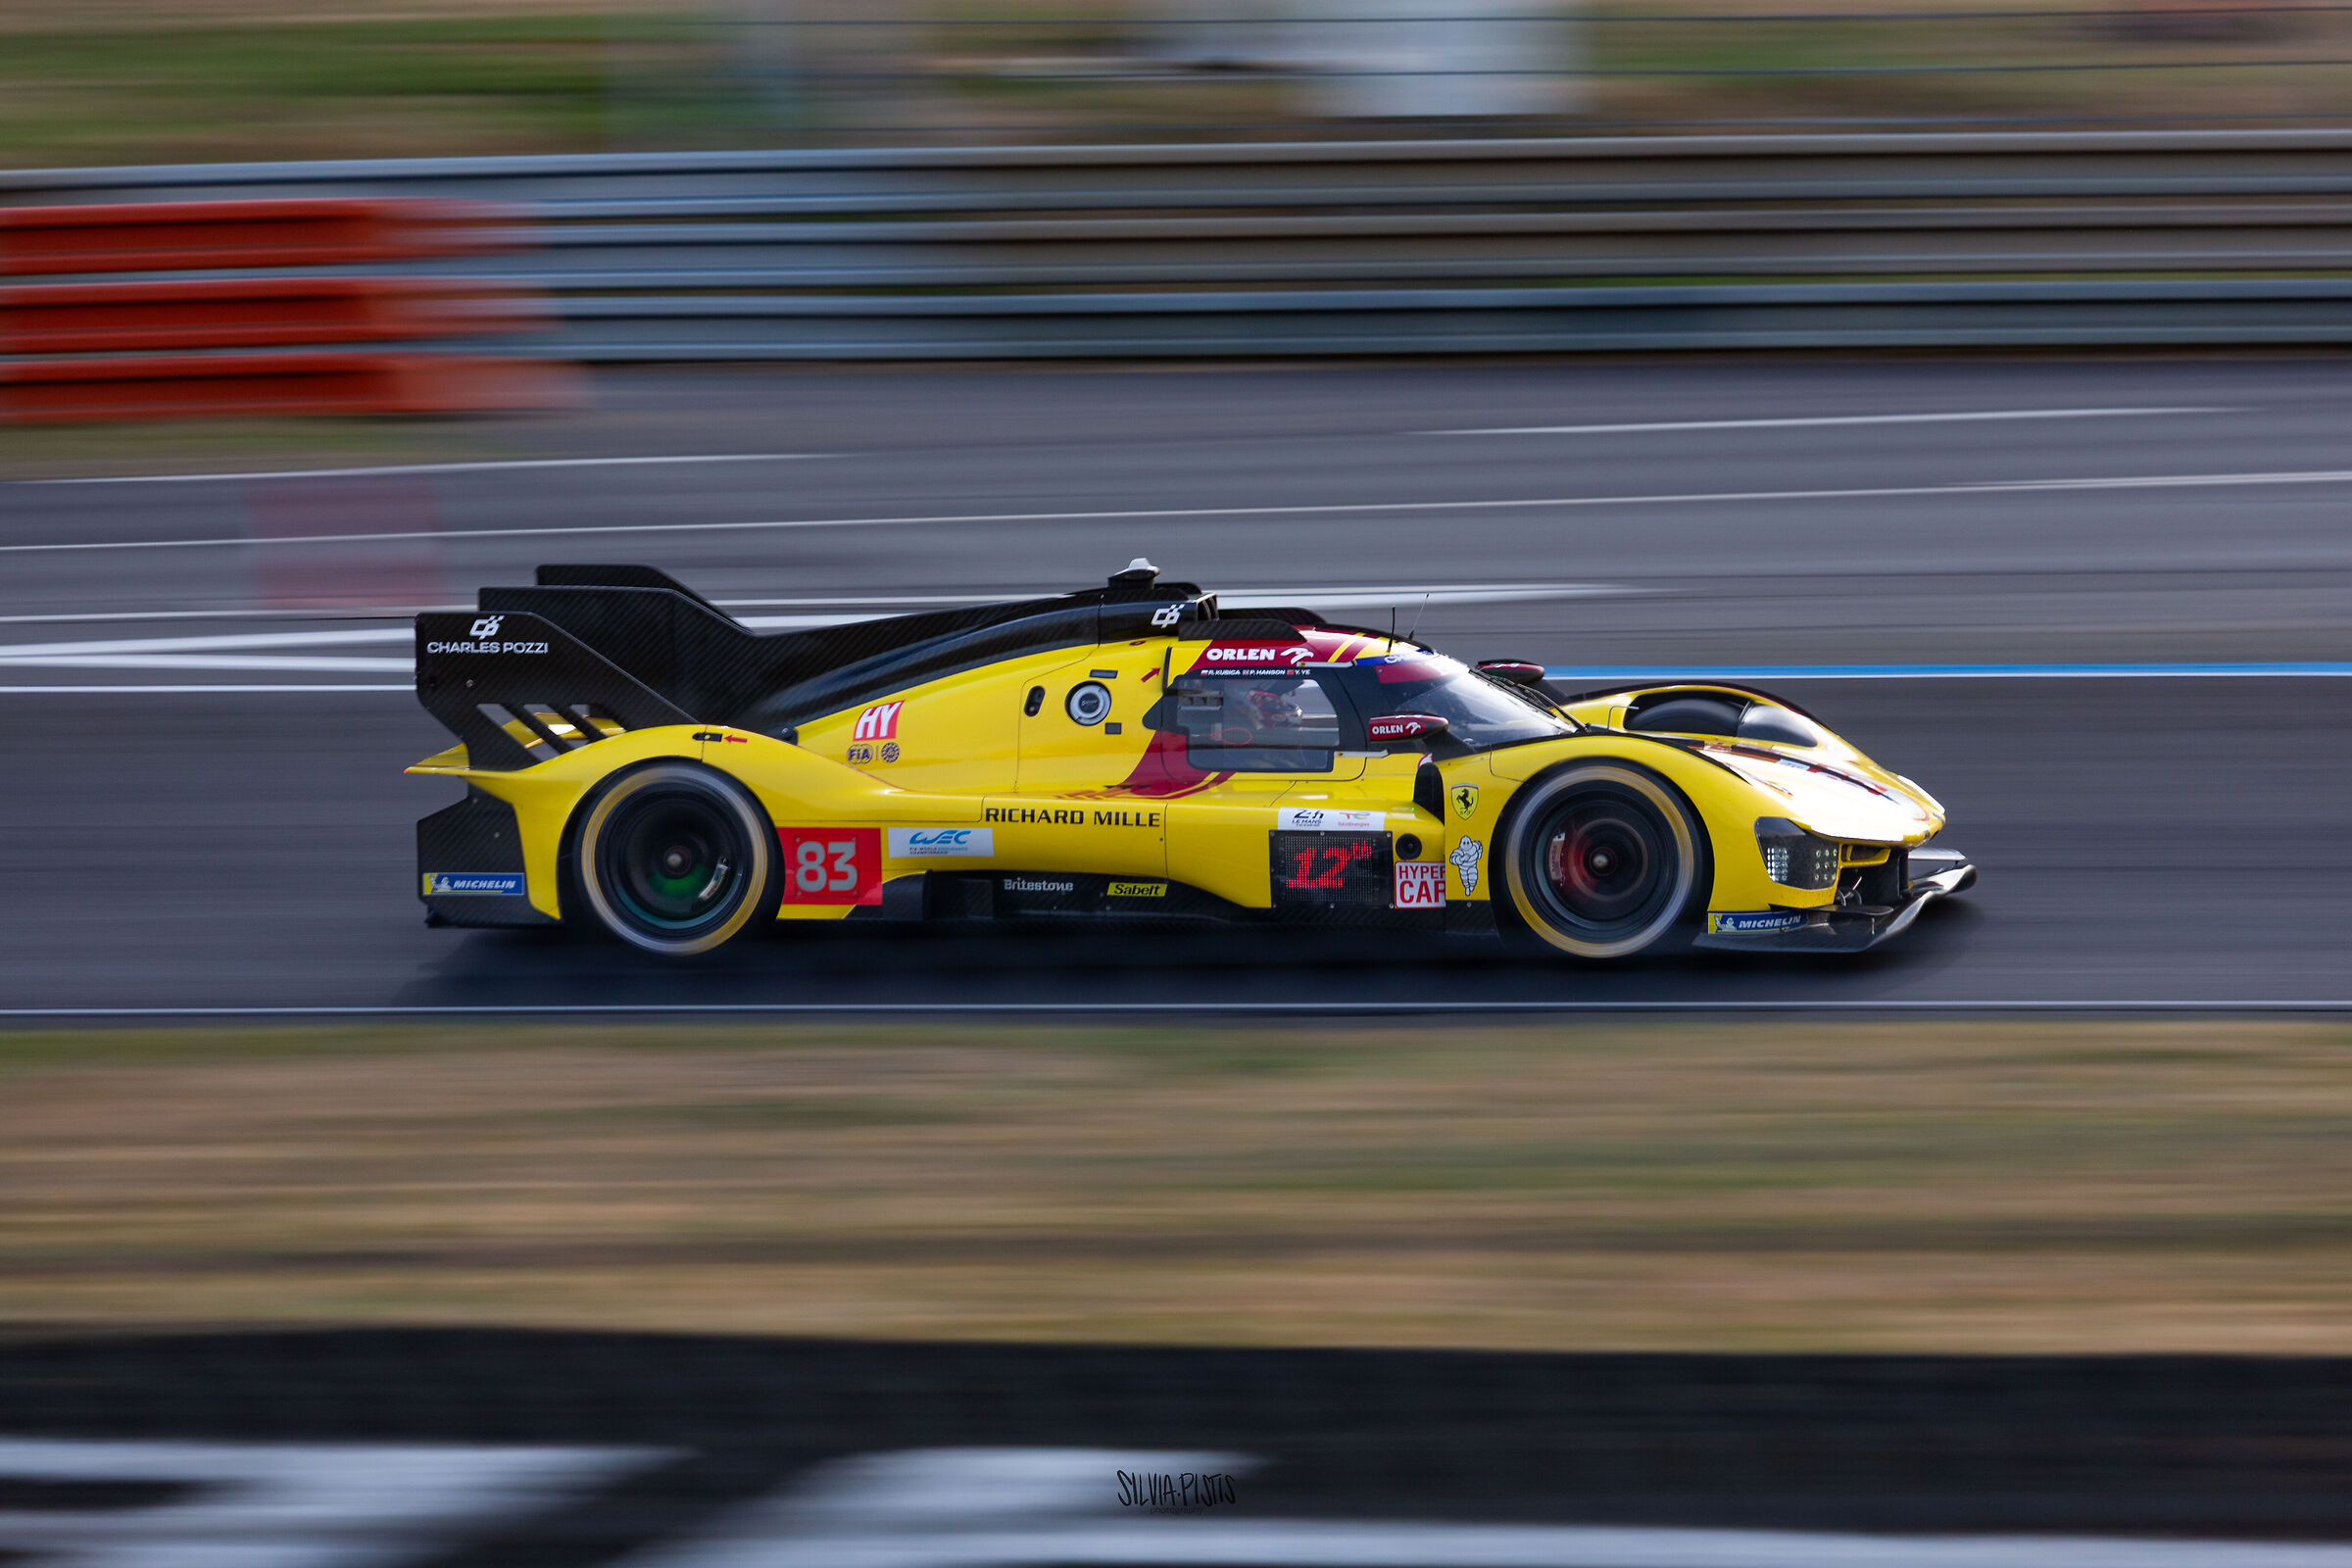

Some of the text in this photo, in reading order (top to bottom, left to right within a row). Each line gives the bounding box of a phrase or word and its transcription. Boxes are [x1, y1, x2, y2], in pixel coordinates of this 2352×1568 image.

[427, 642, 548, 654] CHARLES POZZI
[1206, 648, 1276, 661] ORLEN
[855, 702, 903, 739] HY
[1372, 725, 1403, 734] ORLEN
[985, 808, 1160, 827] RICHARD MILLE
[909, 830, 971, 845] WEC
[796, 840, 858, 892] 83
[453, 880, 516, 889] MICHELIN
[1004, 877, 1073, 892] Britestone
[1739, 915, 1801, 929] MICHELIN
